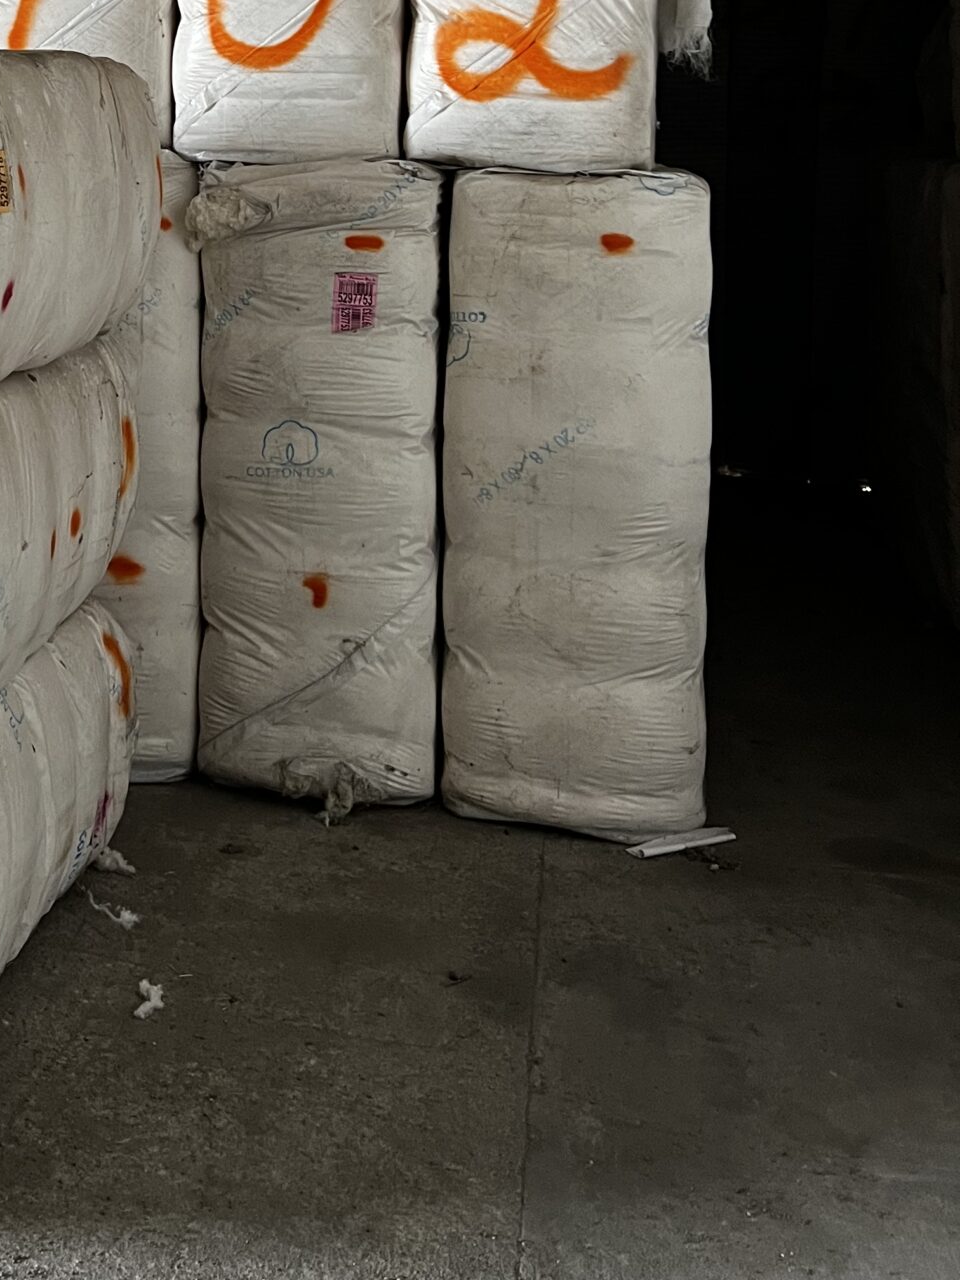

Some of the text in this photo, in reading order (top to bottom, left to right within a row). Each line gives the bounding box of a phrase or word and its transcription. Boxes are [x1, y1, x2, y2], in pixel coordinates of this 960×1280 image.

[337, 291, 373, 307] 5297753
[341, 307, 351, 332] 5297753
[553, 427, 576, 449] 20
[538, 440, 558, 455] X
[246, 465, 335, 479] COTTON USA
